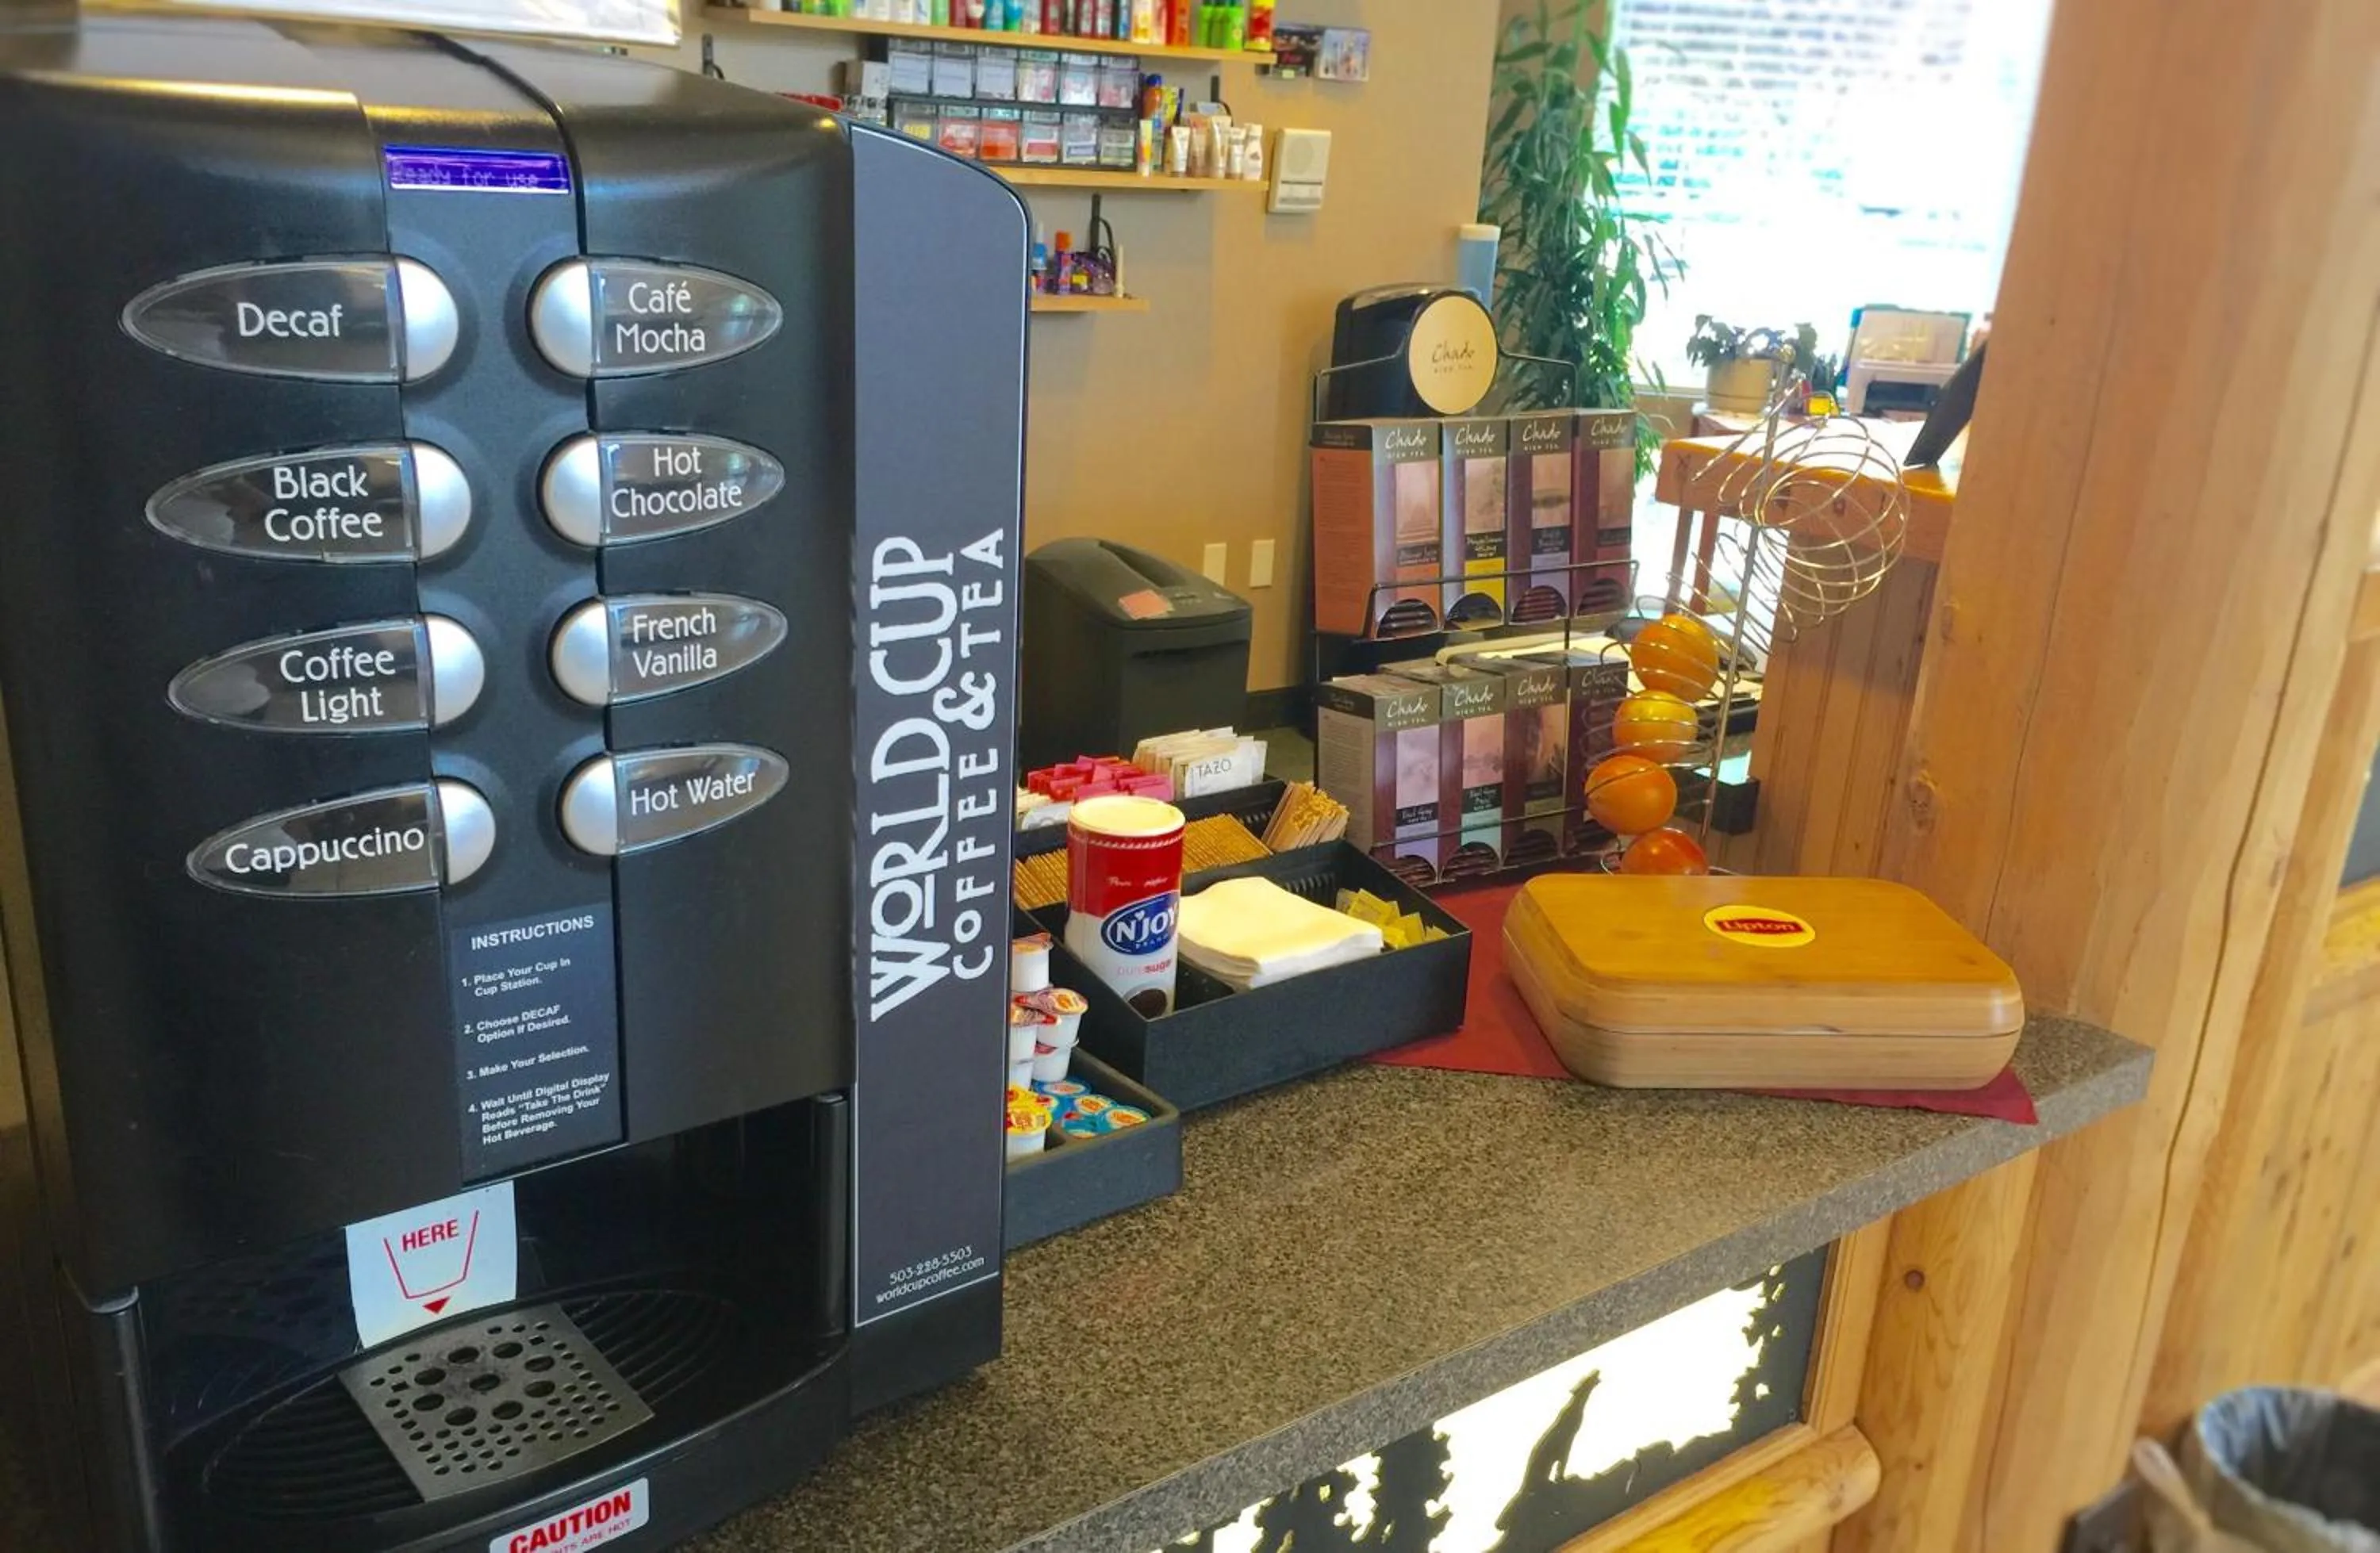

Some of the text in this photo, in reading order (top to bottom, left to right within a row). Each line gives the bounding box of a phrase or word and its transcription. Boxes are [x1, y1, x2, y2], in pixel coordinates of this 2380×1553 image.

[628, 282, 691, 315] Café
[236, 301, 344, 338] Decaf
[616, 324, 706, 355] Mocha
[653, 446, 703, 476] Hot
[274, 465, 369, 500] Black
[610, 482, 743, 520] Chocolate
[264, 506, 384, 543] Coffee
[632, 608, 716, 642] French
[279, 648, 396, 684] Coffee
[631, 643, 718, 679] Vanilla
[301, 688, 384, 723] Light
[932, 528, 1004, 980] COFFEE & TEA
[1196, 759, 1232, 780] TAZO
[631, 771, 756, 815] Hot Water
[869, 536, 958, 1022] WORLD CUP
[224, 826, 425, 874] Cappuccino
[471, 915, 594, 951] INSTRUCTIONS
[462, 957, 570, 987] 1. Place Your Cup In
[474, 976, 543, 997] Cup Station.
[464, 1004, 561, 1034] 2. Choose DECAF
[477, 1014, 572, 1044] Option If Desired.
[466, 1045, 590, 1080] 3. Make Your Selection.
[468, 1072, 610, 1114] 4. Wait Until Digital Display
[482, 1107, 516, 1122] Reads
[551, 1093, 571, 1105] The
[482, 1098, 601, 1134] Before Removing Your
[482, 1120, 559, 1145] Hot Beverage.
[401, 1218, 460, 1252] HERE
[876, 1256, 985, 1304] worldcupcoffee.com
[509, 1490, 631, 1553] CAUTION
[582, 1518, 631, 1545] ARE HOT
